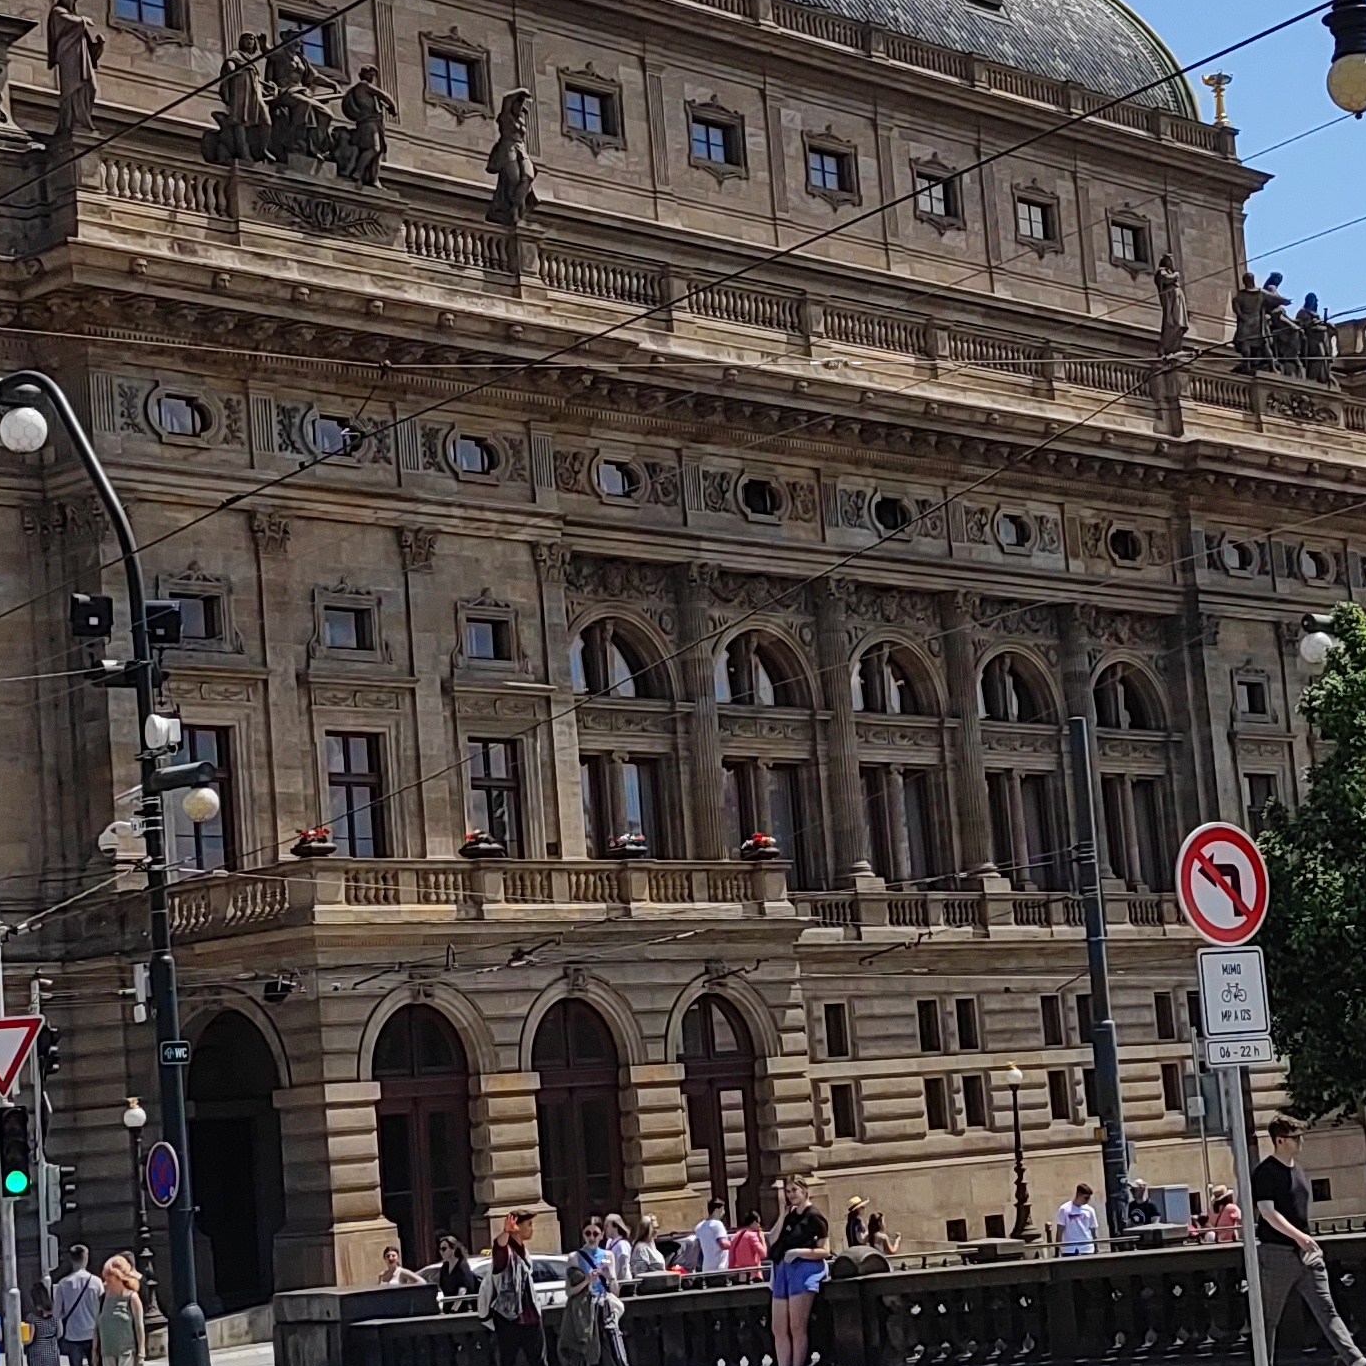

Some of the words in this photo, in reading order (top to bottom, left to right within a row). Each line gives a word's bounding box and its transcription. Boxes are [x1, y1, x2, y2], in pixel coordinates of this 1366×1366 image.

[1221, 963, 1241, 975] MIMO
[174, 1047, 188, 1059] WC
[1219, 1046, 1231, 1059] 06
[1240, 1046, 1251, 1058] 22
[1253, 1046, 1260, 1057] h
